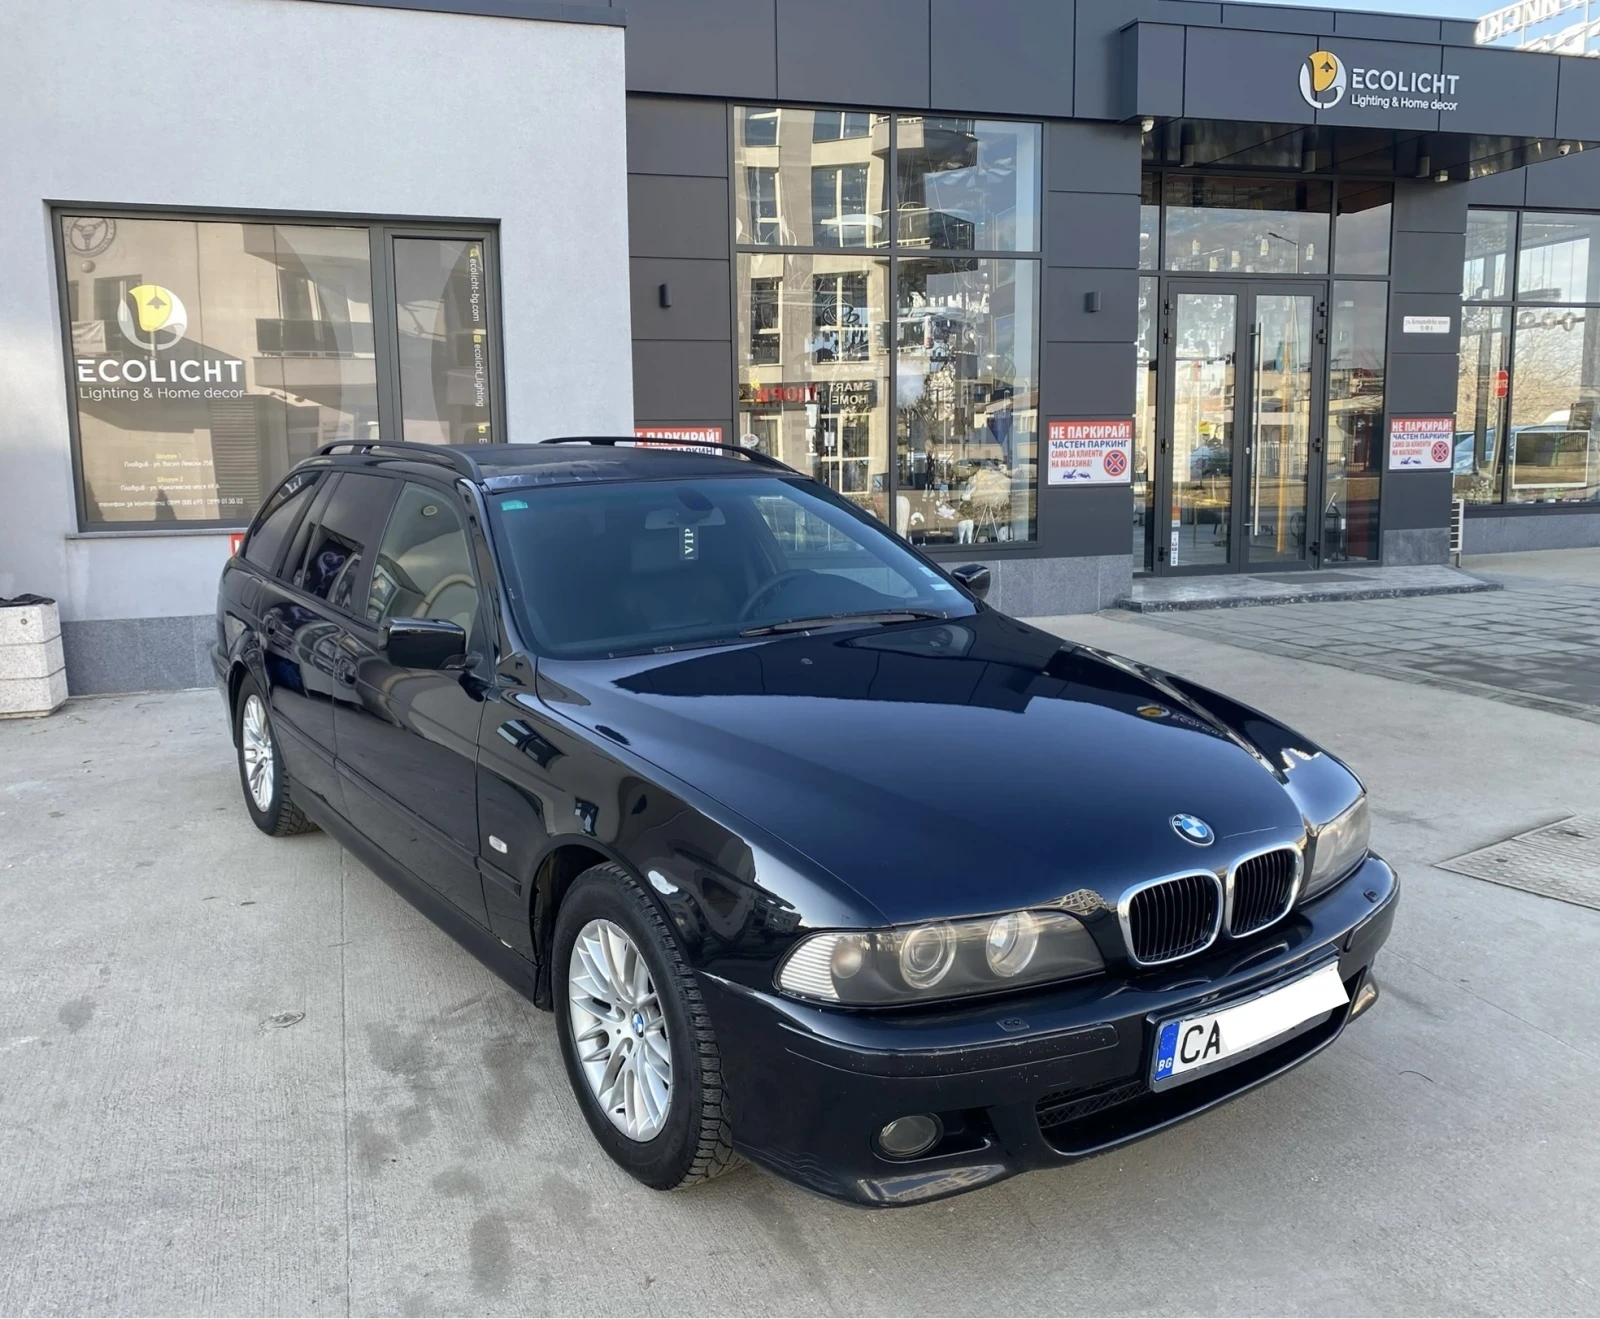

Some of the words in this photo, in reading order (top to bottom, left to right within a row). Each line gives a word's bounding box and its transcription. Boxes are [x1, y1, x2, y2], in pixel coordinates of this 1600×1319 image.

[1352, 68, 1460, 95] ECOLICHT
[1351, 94, 1390, 109] Lighting
[1391, 96, 1399, 108] &
[1400, 97, 1429, 109] Home
[1430, 99, 1458, 111] decor
[470, 258, 480, 322] ecolicht-bg.com
[77, 359, 243, 383] ECOLICHT
[474, 344, 485, 407] ecolicht_lighting
[79, 387, 139, 402] Lighting
[143, 388, 153, 399] &
[157, 388, 200, 399] Home
[204, 387, 244, 399] decor
[1051, 426, 1065, 439] НЕ
[1068, 423, 1130, 438] ПАРКИРАЙ!
[1392, 422, 1404, 432] НЕ
[1405, 419, 1452, 432] ПАРКИРАЙ!
[1052, 440, 1086, 448] ЧАСТЕН
[1051, 450, 1067, 458] САМО
[1069, 450, 1075, 458] ЗА
[1077, 449, 1103, 457] КЛИЕНТИ
[1051, 460, 1059, 468] НА
[1061, 459, 1092, 467] МАГАЗИНА!
[684, 528, 694, 555] VIP
[1180, 1019, 1221, 1064] CA
[1158, 1057, 1173, 1072] BG
